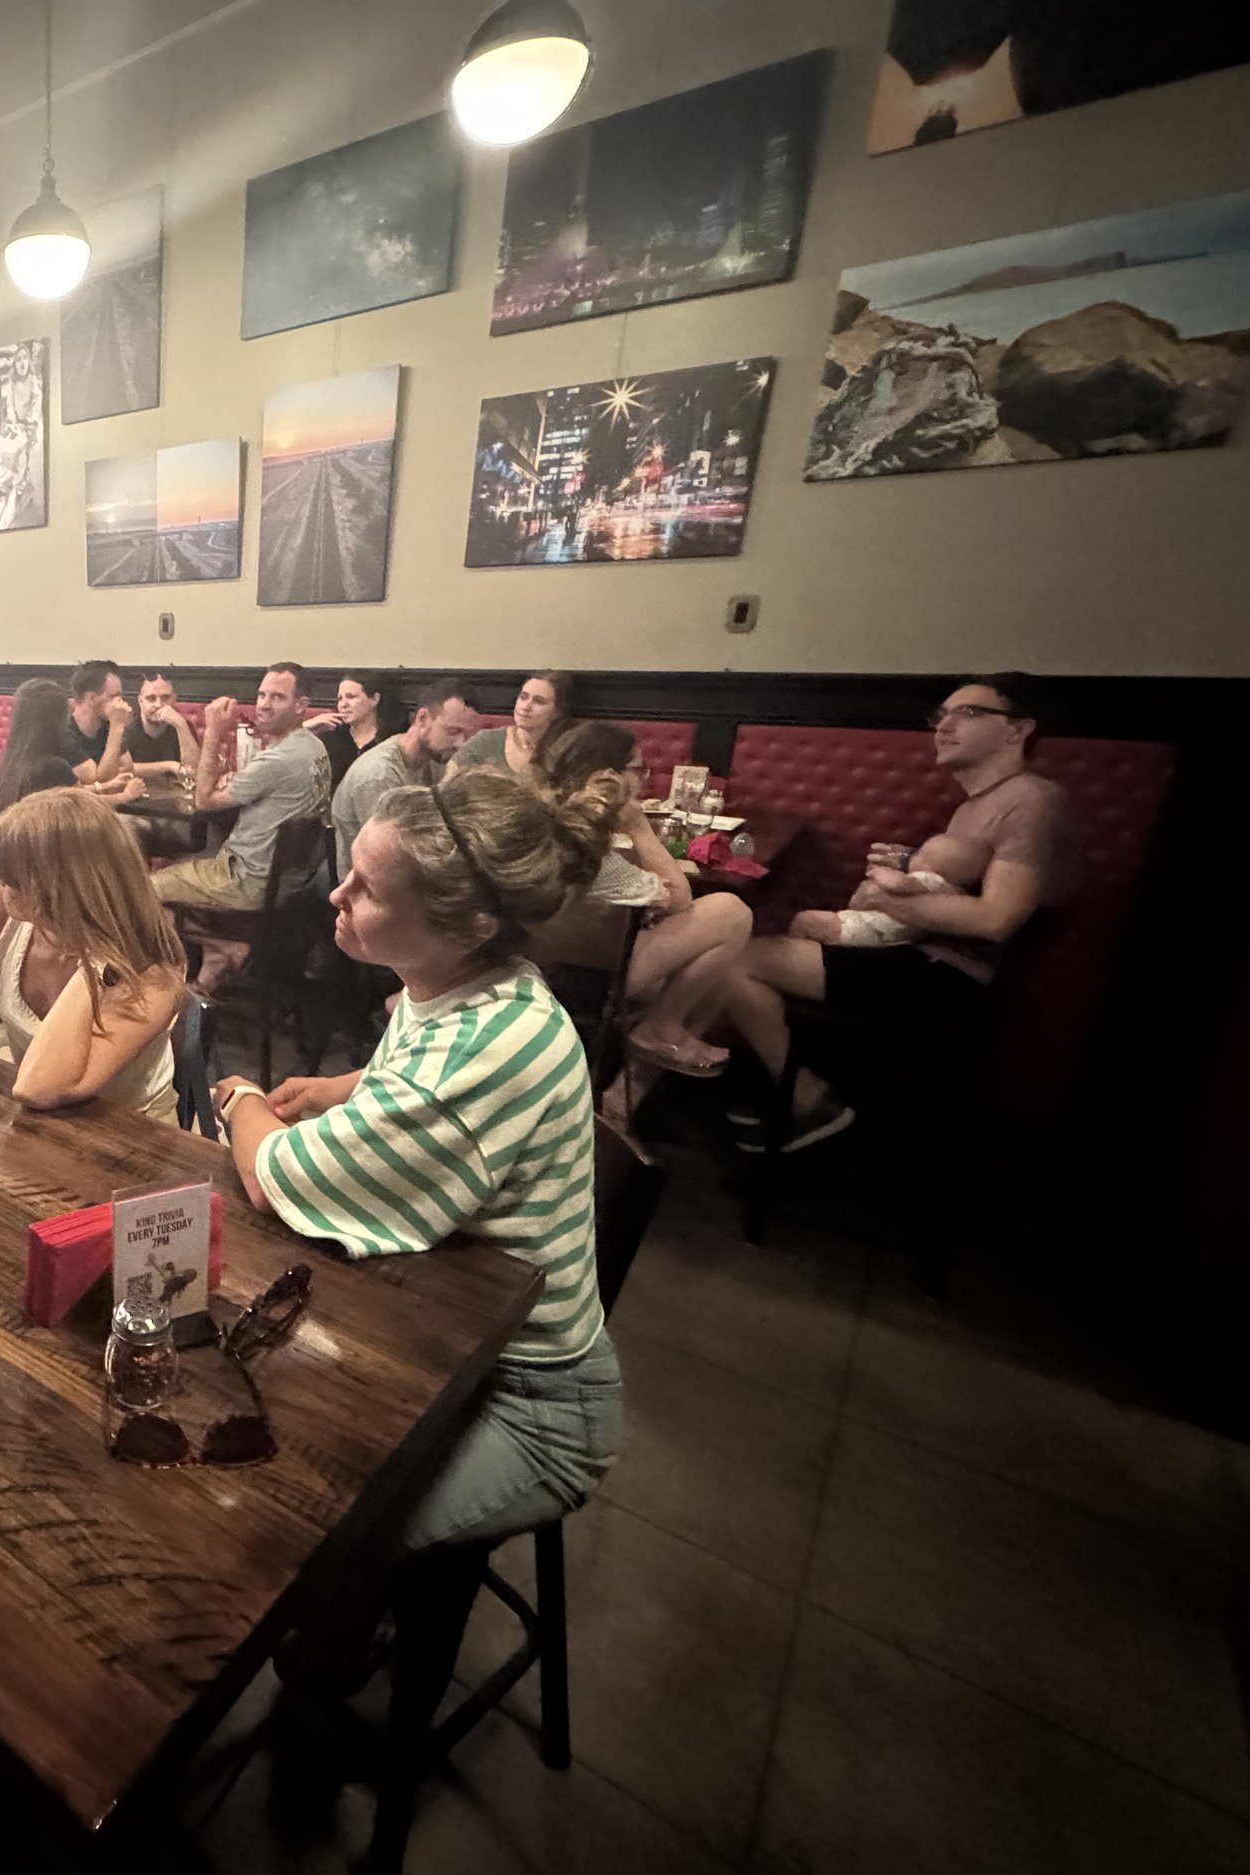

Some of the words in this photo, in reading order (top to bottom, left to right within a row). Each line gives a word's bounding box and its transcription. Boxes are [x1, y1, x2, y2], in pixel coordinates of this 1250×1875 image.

[157, 1208, 184, 1222] TRIVIA
[127, 1226, 154, 1243] EVERY
[156, 1217, 193, 1235] TUESDAY
[151, 1235, 170, 1248] 7PM
